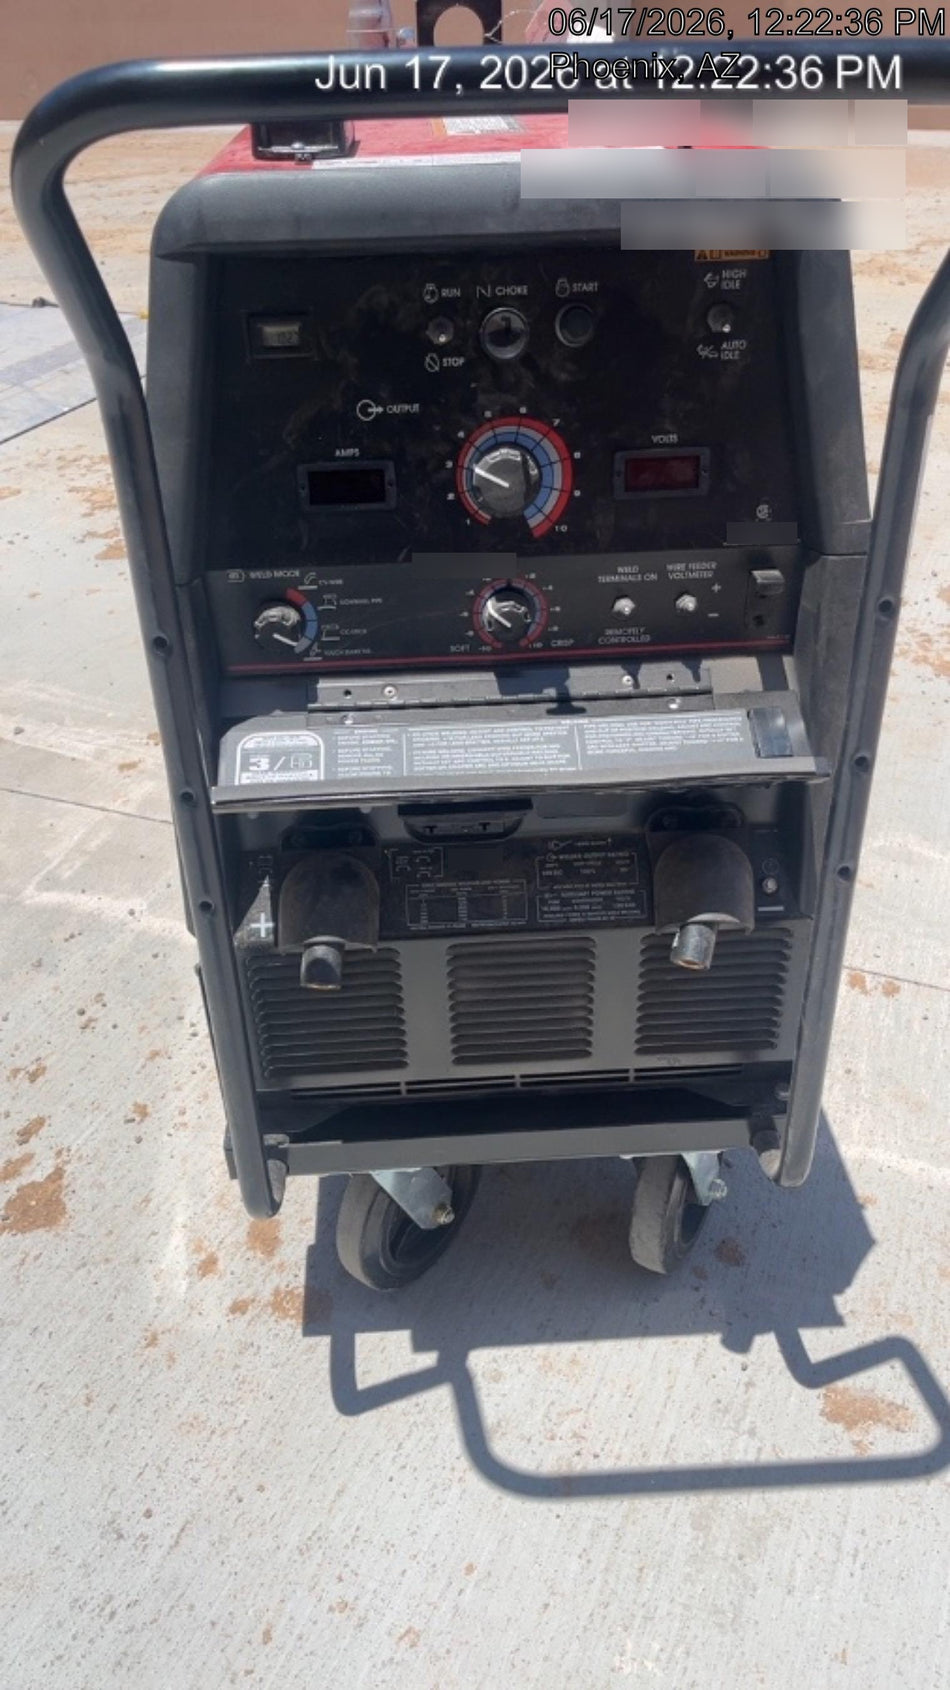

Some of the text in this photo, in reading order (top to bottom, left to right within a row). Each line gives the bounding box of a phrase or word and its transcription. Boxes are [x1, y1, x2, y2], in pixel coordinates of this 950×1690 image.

[722, 269, 747, 279] HIGH
[495, 285, 528, 296] CHOKE
[572, 282, 599, 292] START
[441, 287, 461, 298] RUN
[721, 339, 747, 350] AUTO
[442, 357, 465, 367] STOP
[386, 403, 420, 414] OUTPUT
[651, 434, 678, 444] VOLTS
[335, 448, 360, 457] AMPS
